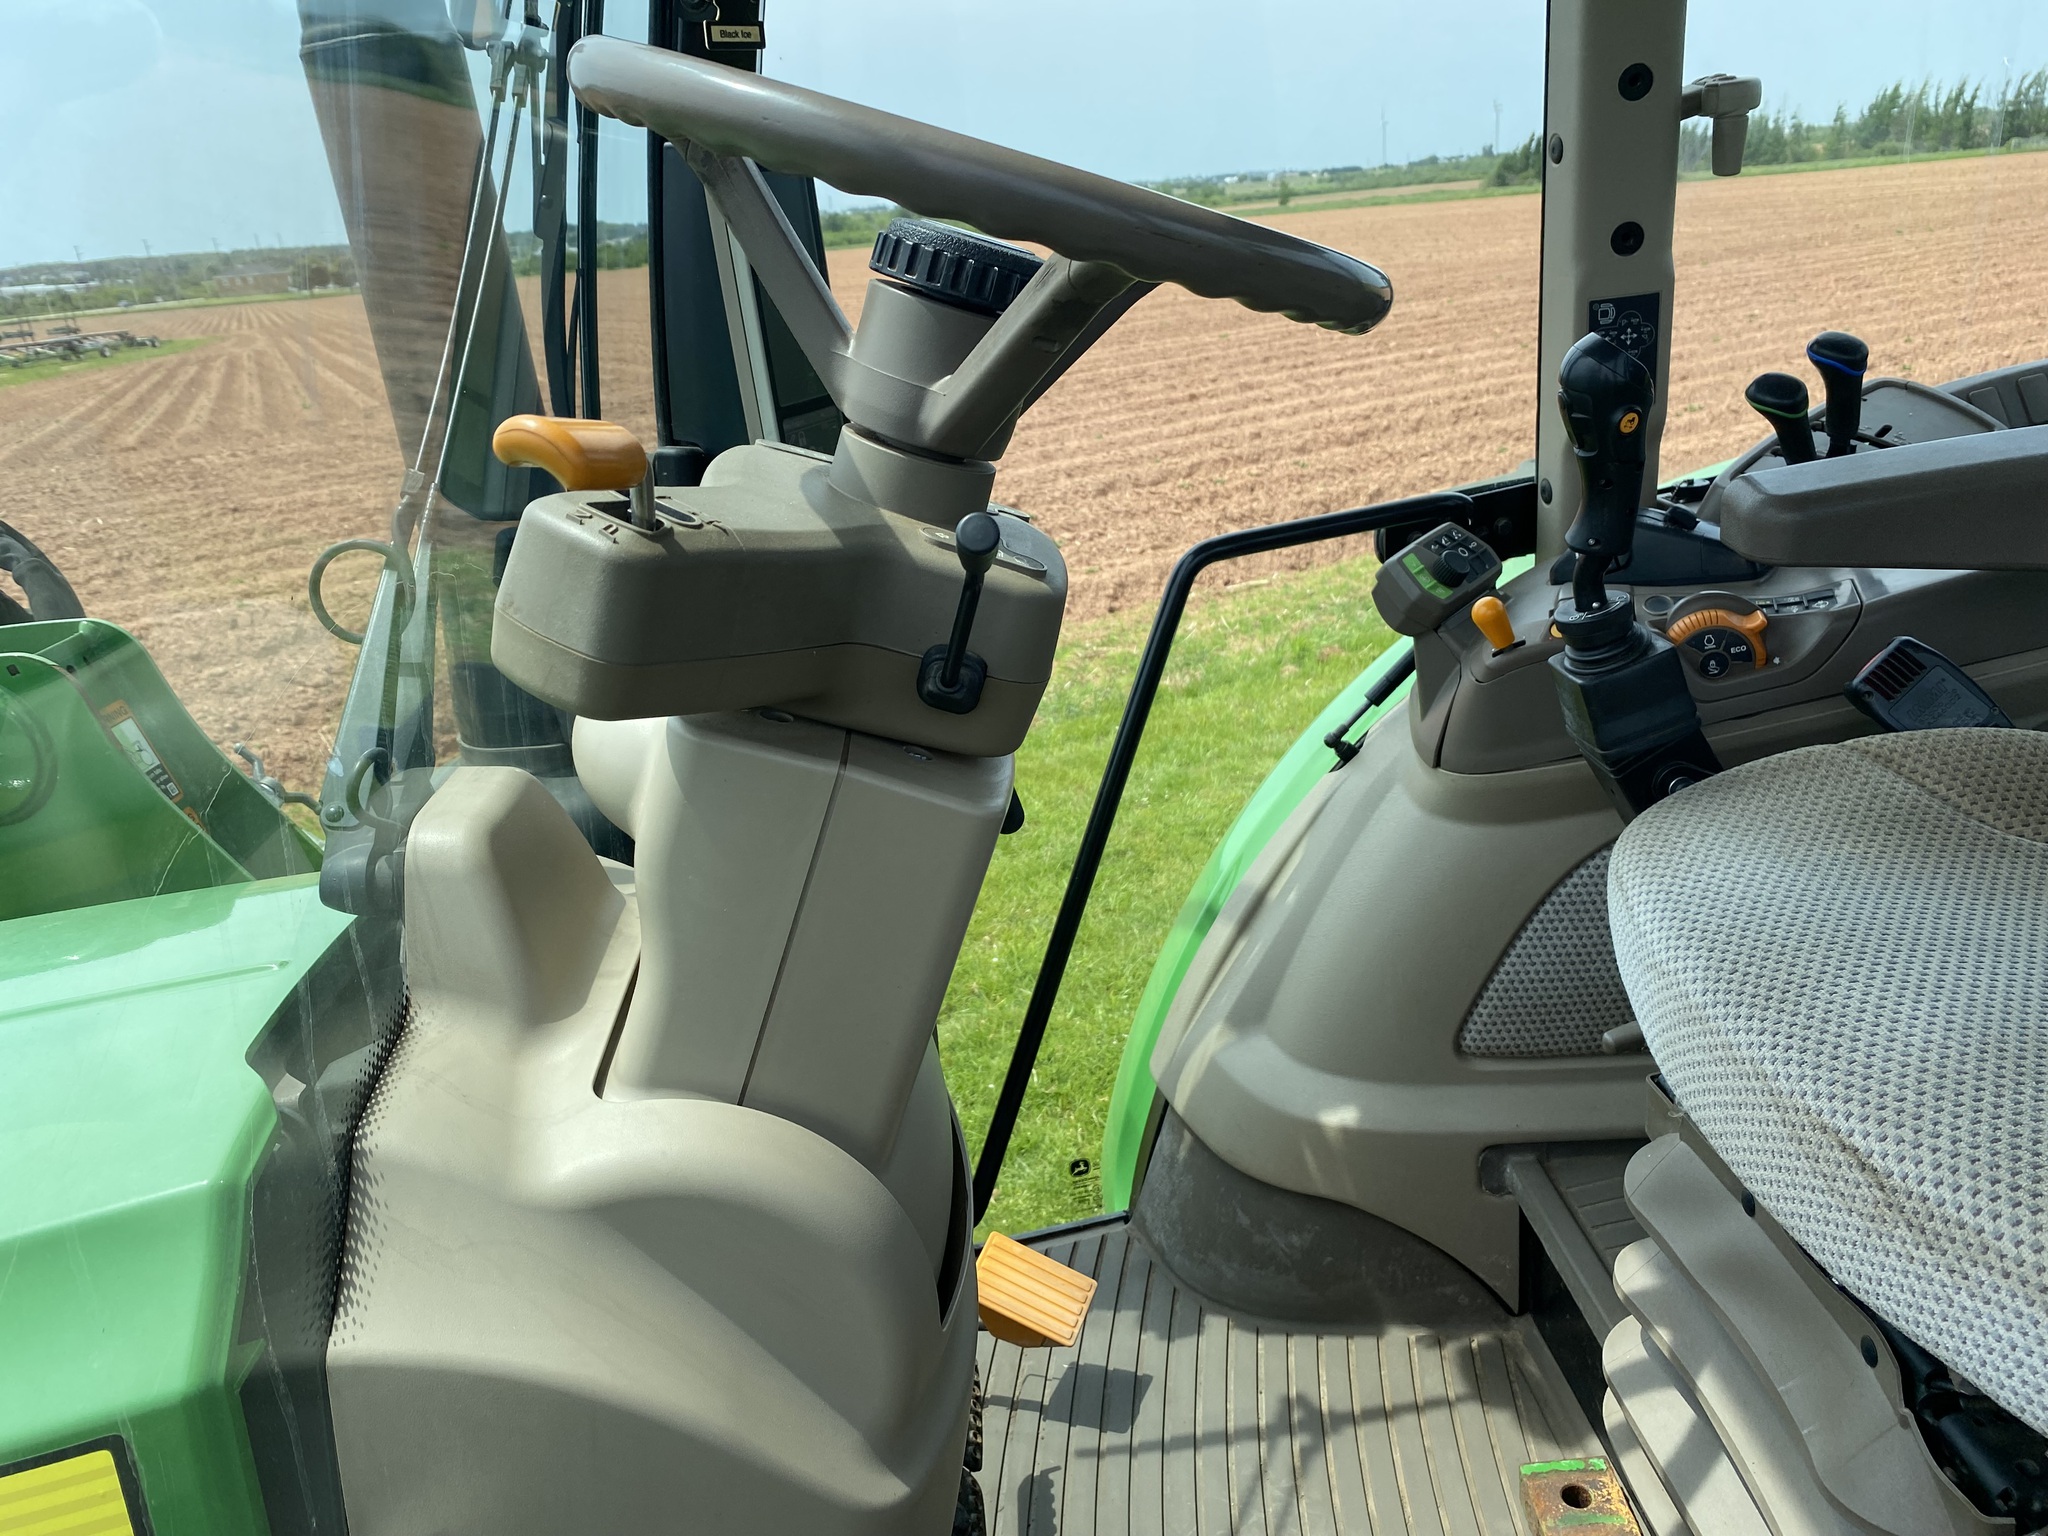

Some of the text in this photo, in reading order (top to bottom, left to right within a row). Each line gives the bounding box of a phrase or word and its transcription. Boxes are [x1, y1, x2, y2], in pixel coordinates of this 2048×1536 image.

[720, 29, 752, 39] Black Ice
[1730, 645, 1747, 654] ECO
